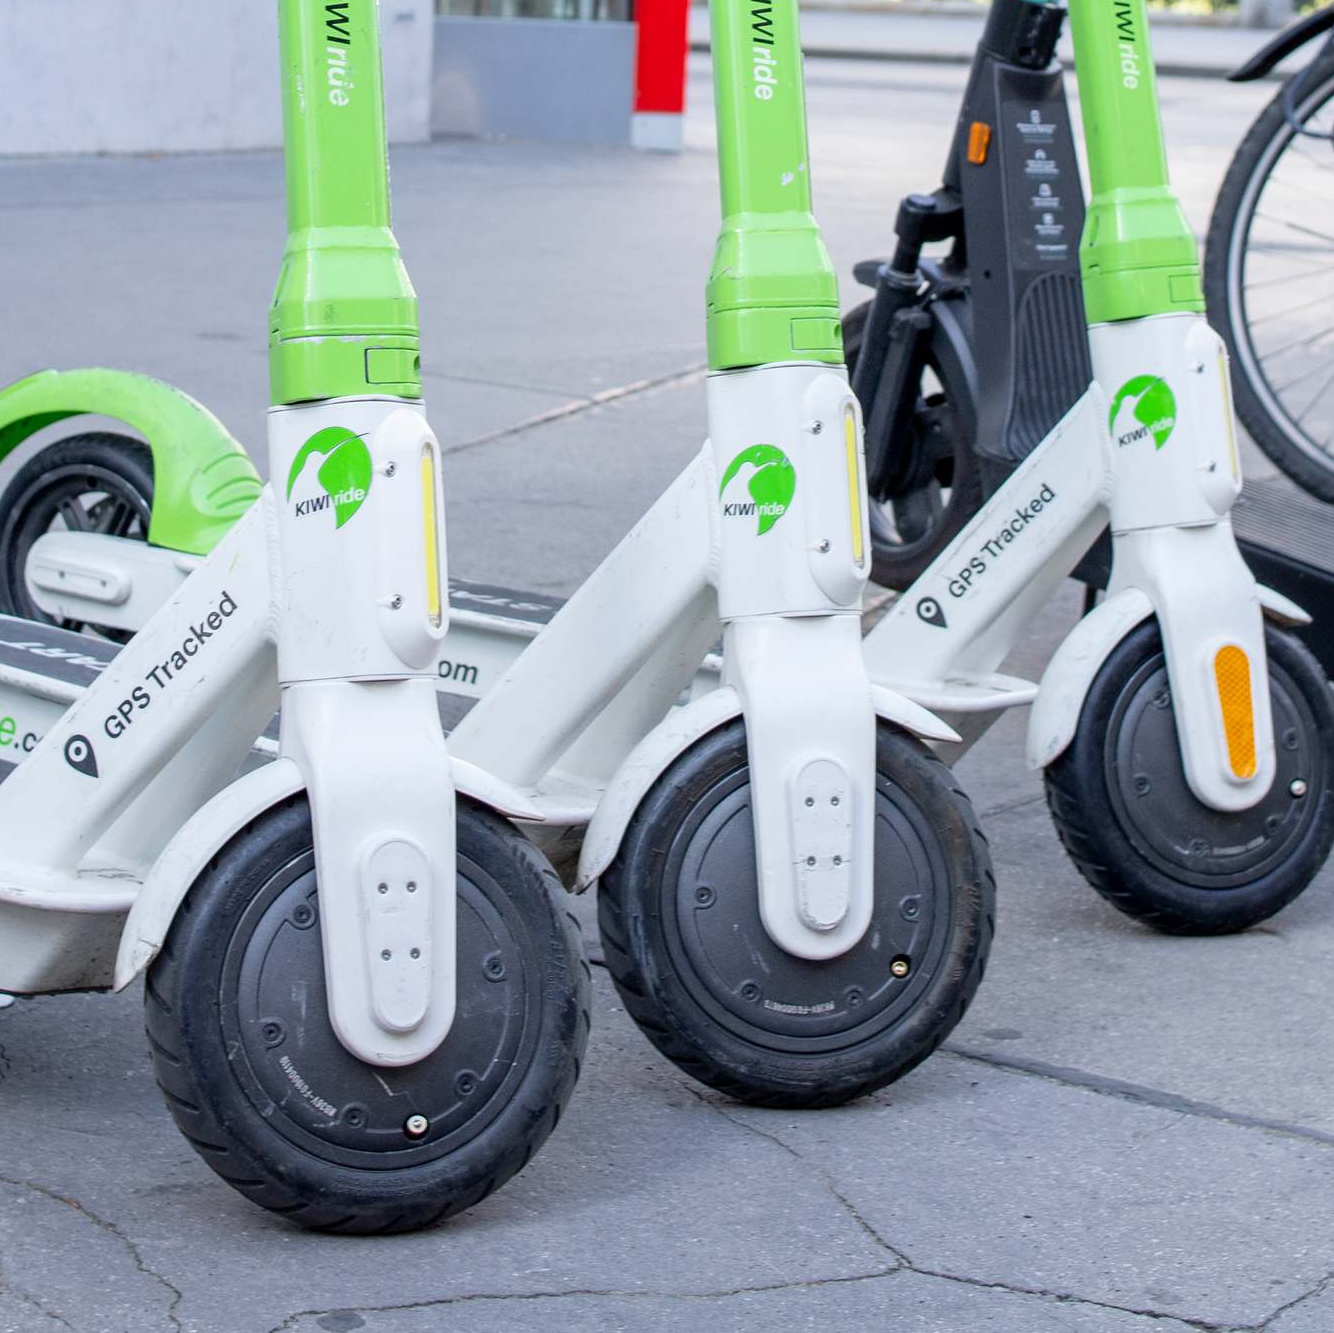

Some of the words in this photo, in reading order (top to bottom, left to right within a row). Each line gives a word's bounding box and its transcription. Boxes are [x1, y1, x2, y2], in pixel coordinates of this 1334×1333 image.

[948, 556, 987, 598] GPS
[980, 482, 1056, 558] Tracked
[104, 686, 151, 739] GPS
[145, 590, 238, 689] Tracked
